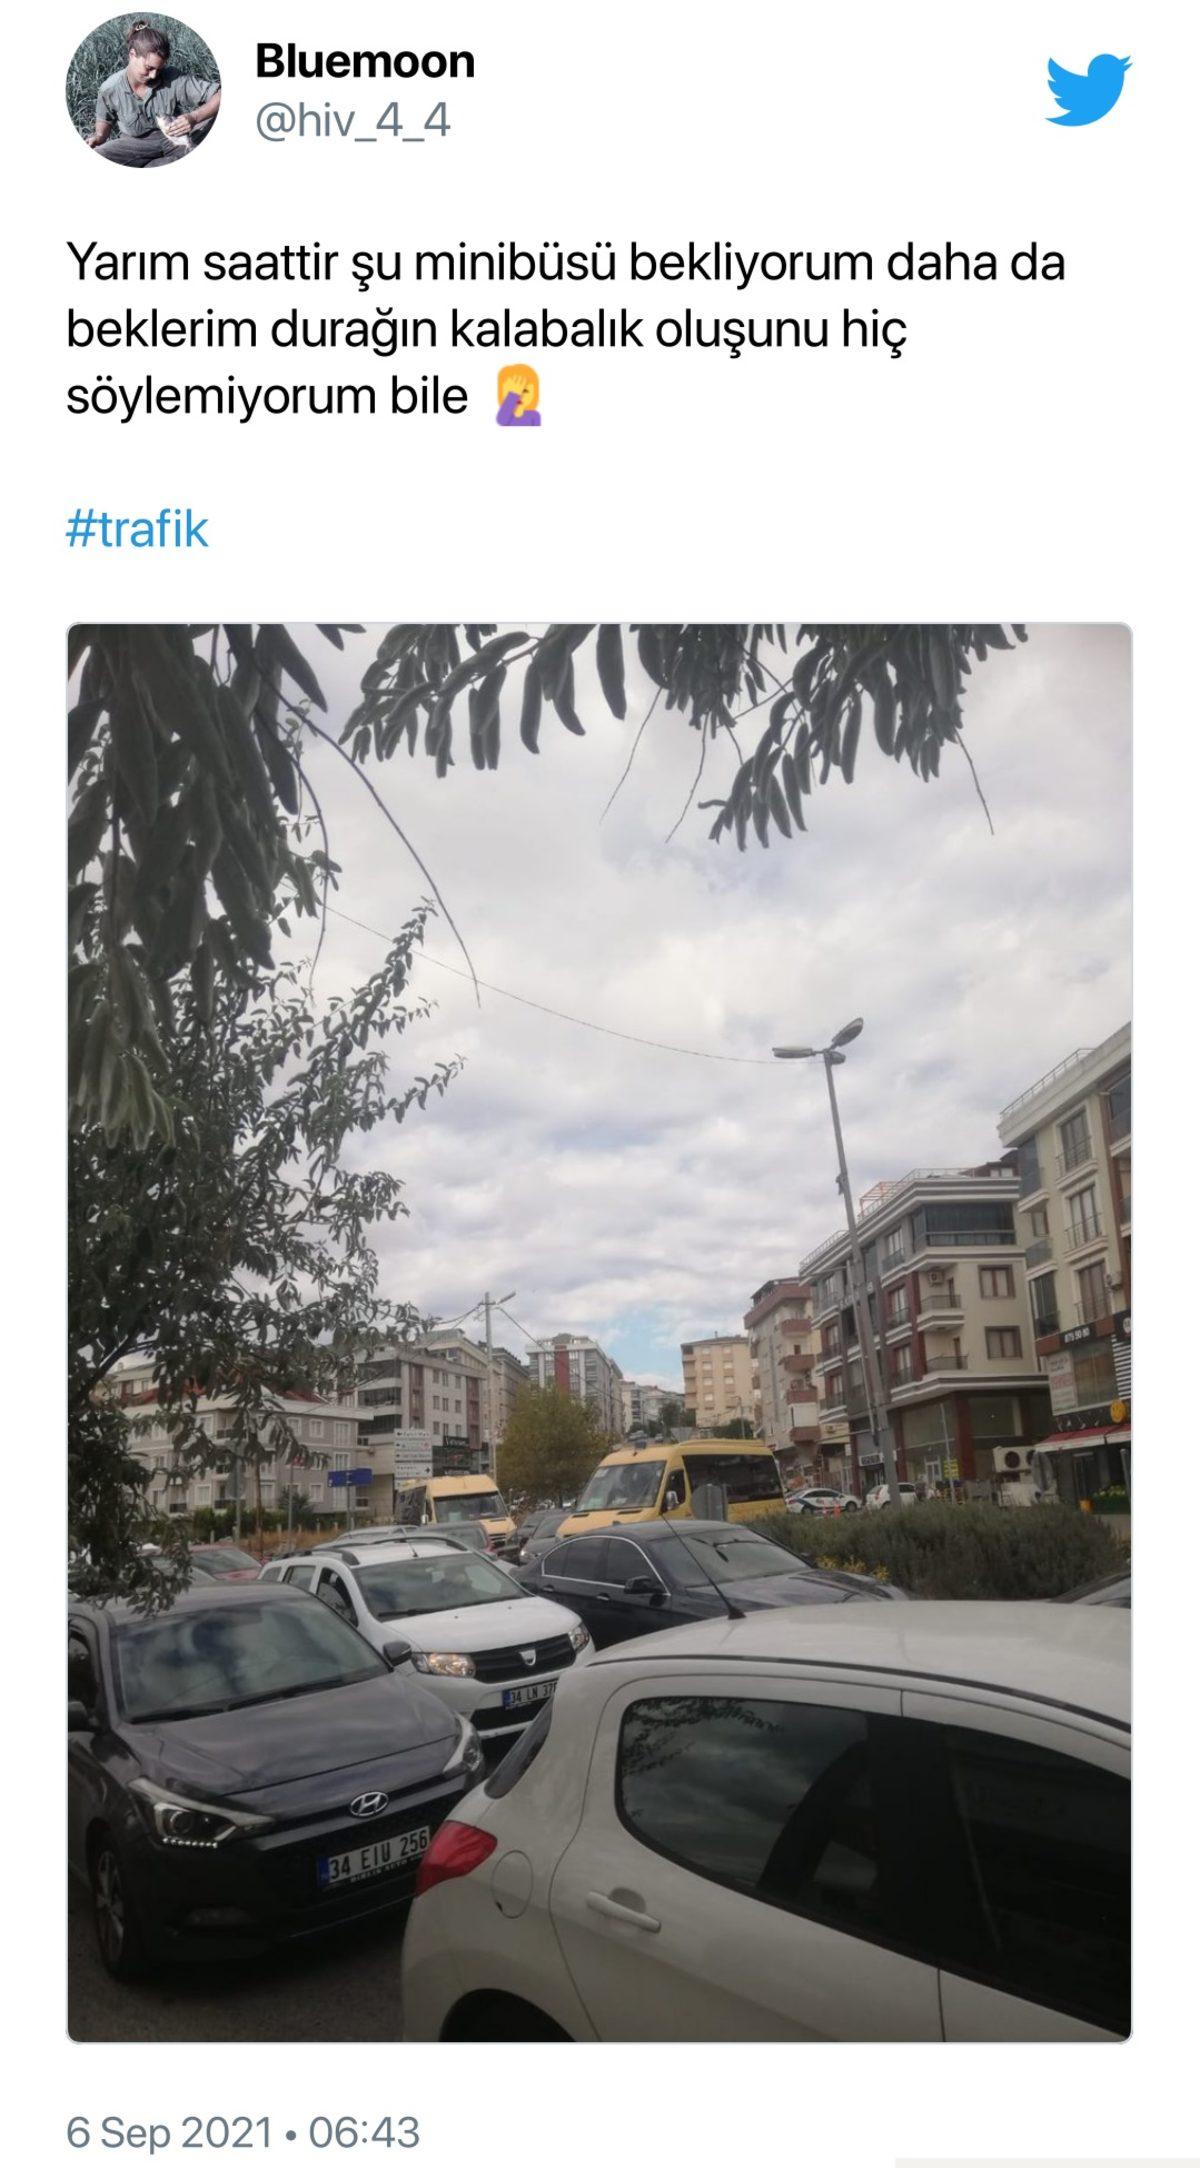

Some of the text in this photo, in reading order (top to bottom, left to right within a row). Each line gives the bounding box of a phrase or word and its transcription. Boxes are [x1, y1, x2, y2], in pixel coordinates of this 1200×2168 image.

[330, 1855, 351, 1880] 34
[360, 1841, 392, 1870] EIU
[399, 1829, 428, 1857] 256
